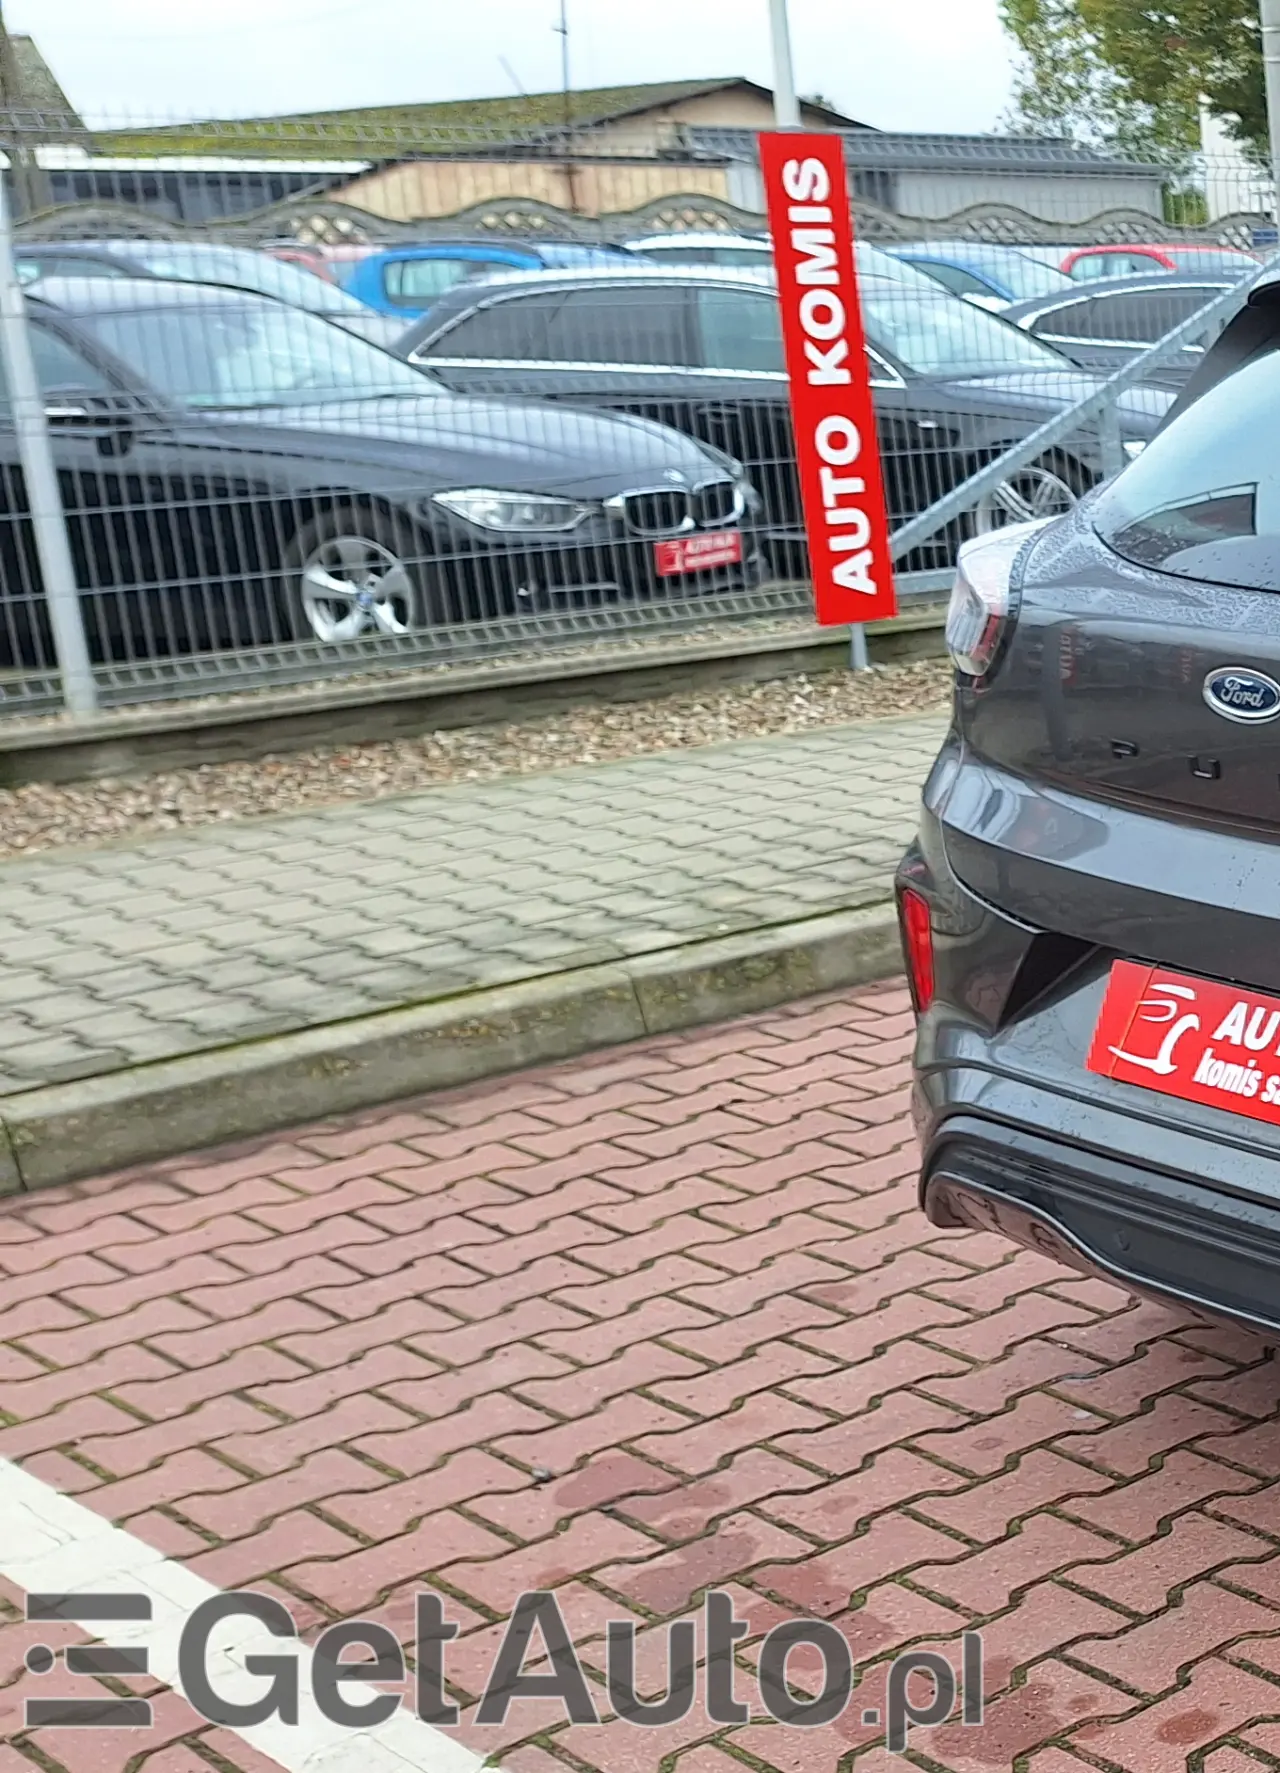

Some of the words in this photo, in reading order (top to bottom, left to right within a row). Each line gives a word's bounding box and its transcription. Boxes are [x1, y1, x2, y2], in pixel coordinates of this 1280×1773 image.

[781, 156, 852, 386] KOMIS
[815, 415, 877, 595] AUTO
[1220, 676, 1265, 709] Ford
[1193, 1047, 1264, 1099] komis
